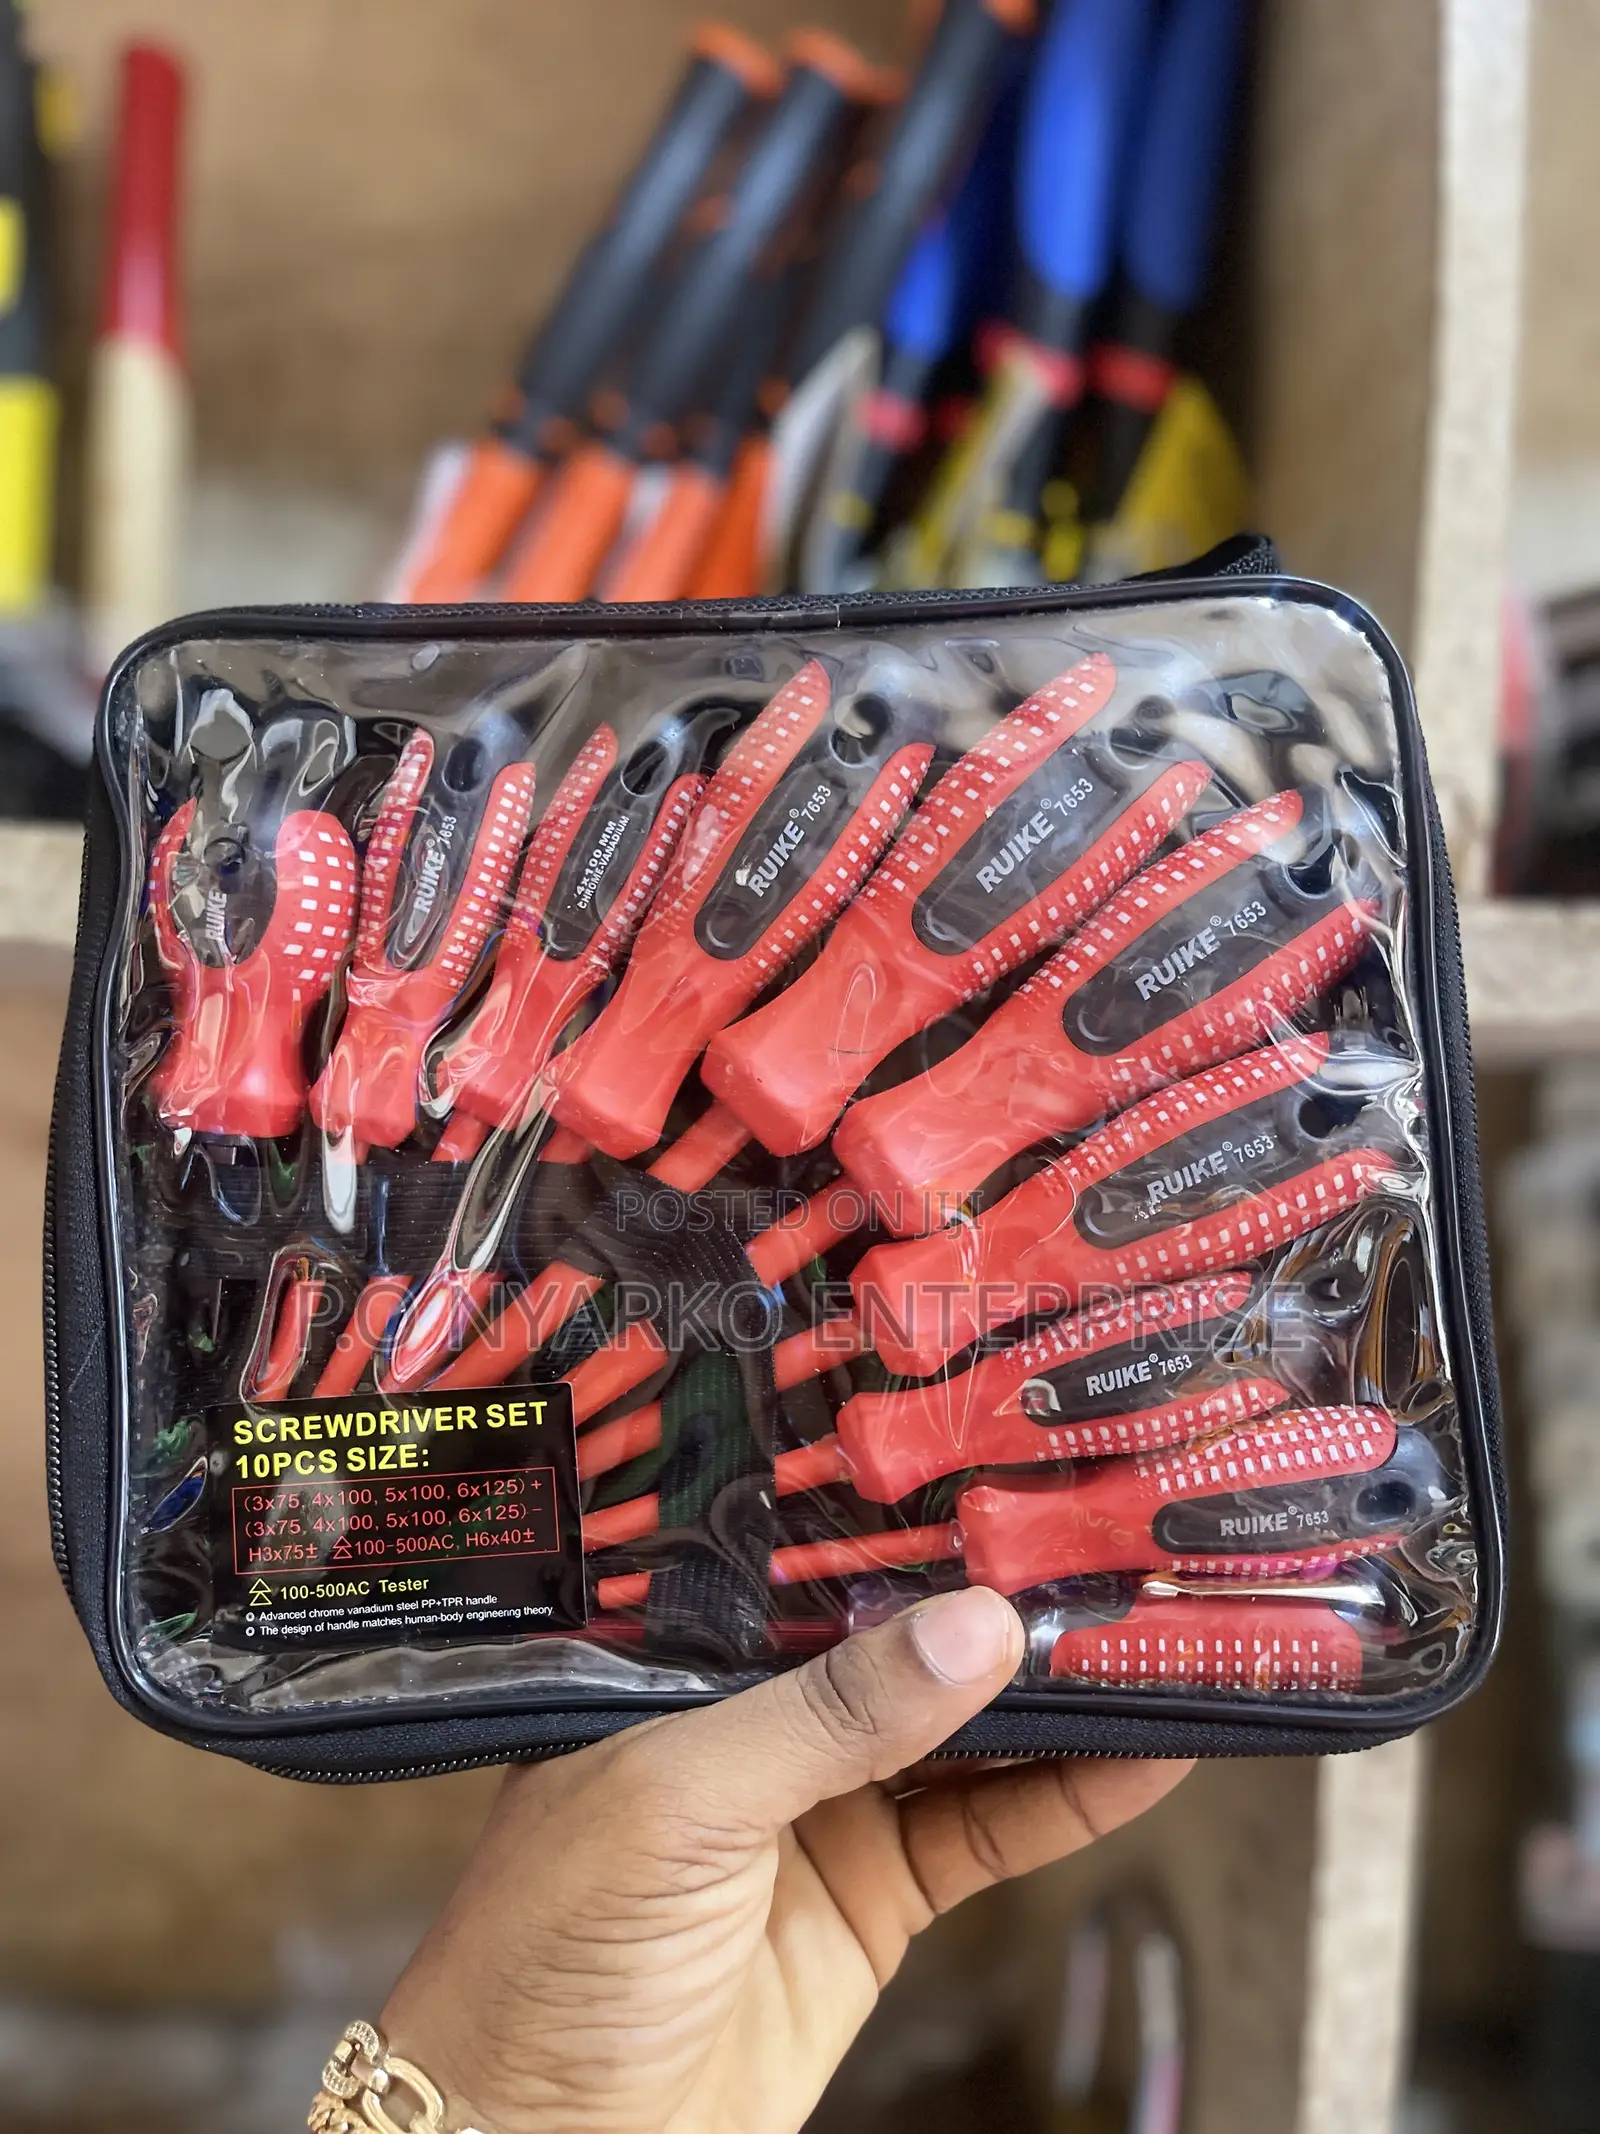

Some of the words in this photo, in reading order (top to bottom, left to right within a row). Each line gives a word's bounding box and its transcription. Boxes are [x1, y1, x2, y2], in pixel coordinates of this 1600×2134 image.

[801, 785, 831, 821] 7653
[1054, 778, 1093, 816] 7653
[599, 820, 617, 847] MM
[577, 815, 630, 909] CHROME-VANADIUM
[205, 890, 227, 941] RUIKE
[1223, 900, 1267, 936] 7653
[1233, 1134, 1275, 1163] 7653
[1158, 1354, 1192, 1376] 7653
[233, 1404, 477, 1445] SCREWDRIVER
[486, 1400, 548, 1429] SET
[235, 1449, 338, 1480] 10PCS
[346, 1443, 430, 1472] SIZE:
[312, 1487, 379, 1506] 4x100,
[385, 1484, 451, 1502] 5x100,
[457, 1477, 525, 1498] 6x125)
[313, 1513, 380, 1533] 4x100,
[386, 1509, 452, 1528] 5x100,
[458, 1503, 527, 1523] 6x125)
[1296, 1510, 1329, 1528] 7653
[280, 1580, 370, 1600] 100-500AC
[378, 1578, 429, 1593] Tester
[260, 1610, 306, 1621] Advanced
[308, 1608, 345, 1618] chrome
[347, 1603, 394, 1615] vanadium
[396, 1600, 419, 1611] steel
[421, 1597, 464, 1609] PP+TPR
[465, 1594, 498, 1604] handle
[260, 1625, 279, 1636] The
[281, 1622, 312, 1635] design
[314, 1621, 325, 1632] of
[327, 1620, 360, 1631] handle
[362, 1614, 402, 1628] matches
[404, 1611, 464, 1625] human-body
[466, 1607, 521, 1622] engineering
